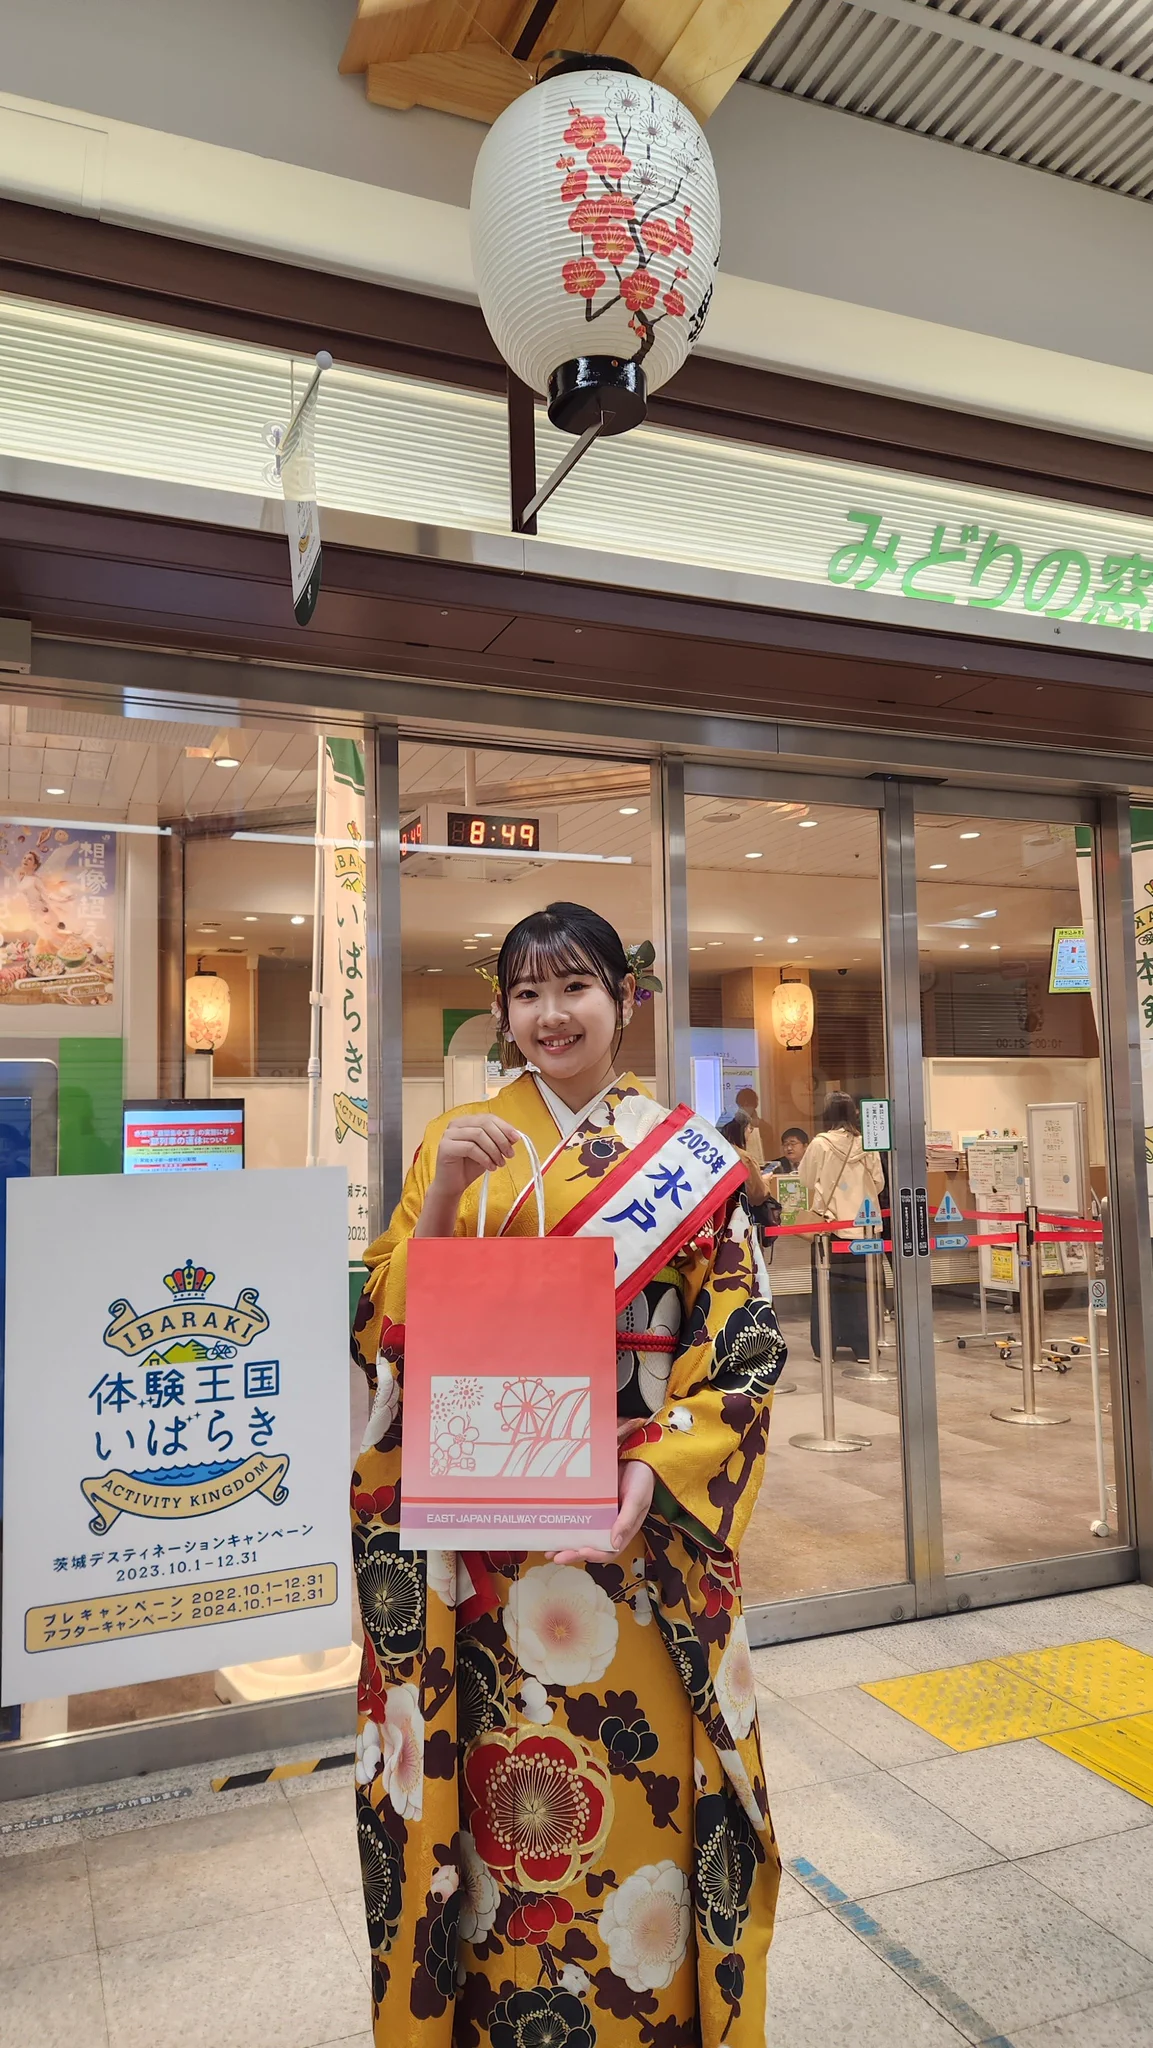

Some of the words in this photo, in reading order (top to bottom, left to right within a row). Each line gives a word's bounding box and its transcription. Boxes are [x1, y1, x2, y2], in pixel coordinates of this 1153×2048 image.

[828, 511, 1153, 632] みどりの窓
[470, 821, 534, 847] 8:49
[677, 1128, 726, 1174] 2023年
[602, 1163, 692, 1270] 水戸
[123, 1311, 254, 1348] IBARAKI
[89, 1359, 280, 1416] 体験王国
[95, 1407, 277, 1461] いばらき
[101, 1479, 182, 1509] ACTIVITY
[190, 1461, 270, 1507] KINGDOM
[427, 1514, 455, 1523] EAST
[456, 1514, 491, 1524] JAPAN
[493, 1514, 537, 1524] RAILWAY
[539, 1515, 592, 1524] COMPANY
[53, 1524, 314, 1572] 茨城デスティネーションキャンペーン
[44, 1596, 183, 1626] プレキャンペーン
[44, 1611, 183, 1642] アフターキャンペーン
